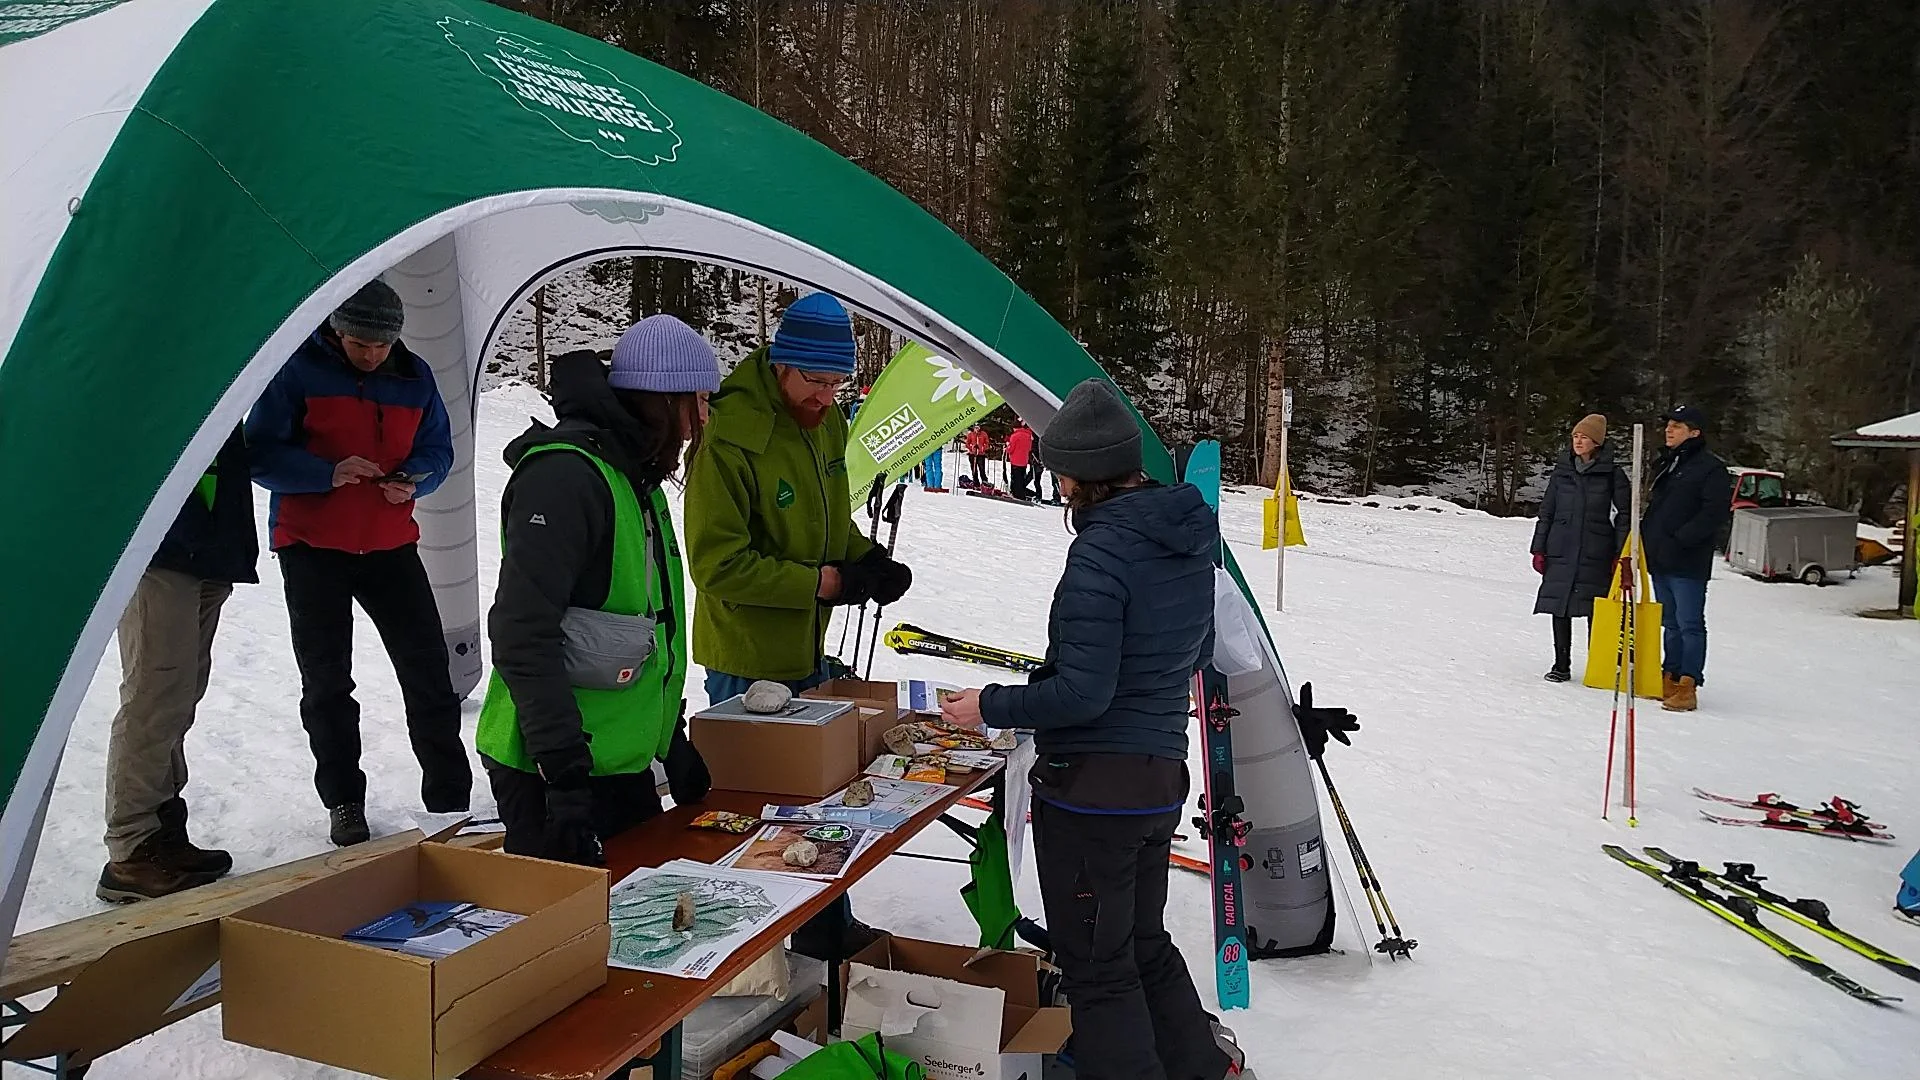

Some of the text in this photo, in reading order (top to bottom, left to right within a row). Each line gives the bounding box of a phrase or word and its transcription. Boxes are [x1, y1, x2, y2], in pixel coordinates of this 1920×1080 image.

[483, 53, 636, 109] TEGERNSEE
[507, 78, 663, 133] SCHLIERSEE
[876, 408, 910, 440] DAV
[908, 639, 947, 652] BLIZZARD
[1223, 882, 1236, 926] RADICAL
[1223, 943, 1240, 963] 88
[924, 1055, 974, 1074] Seeberger
